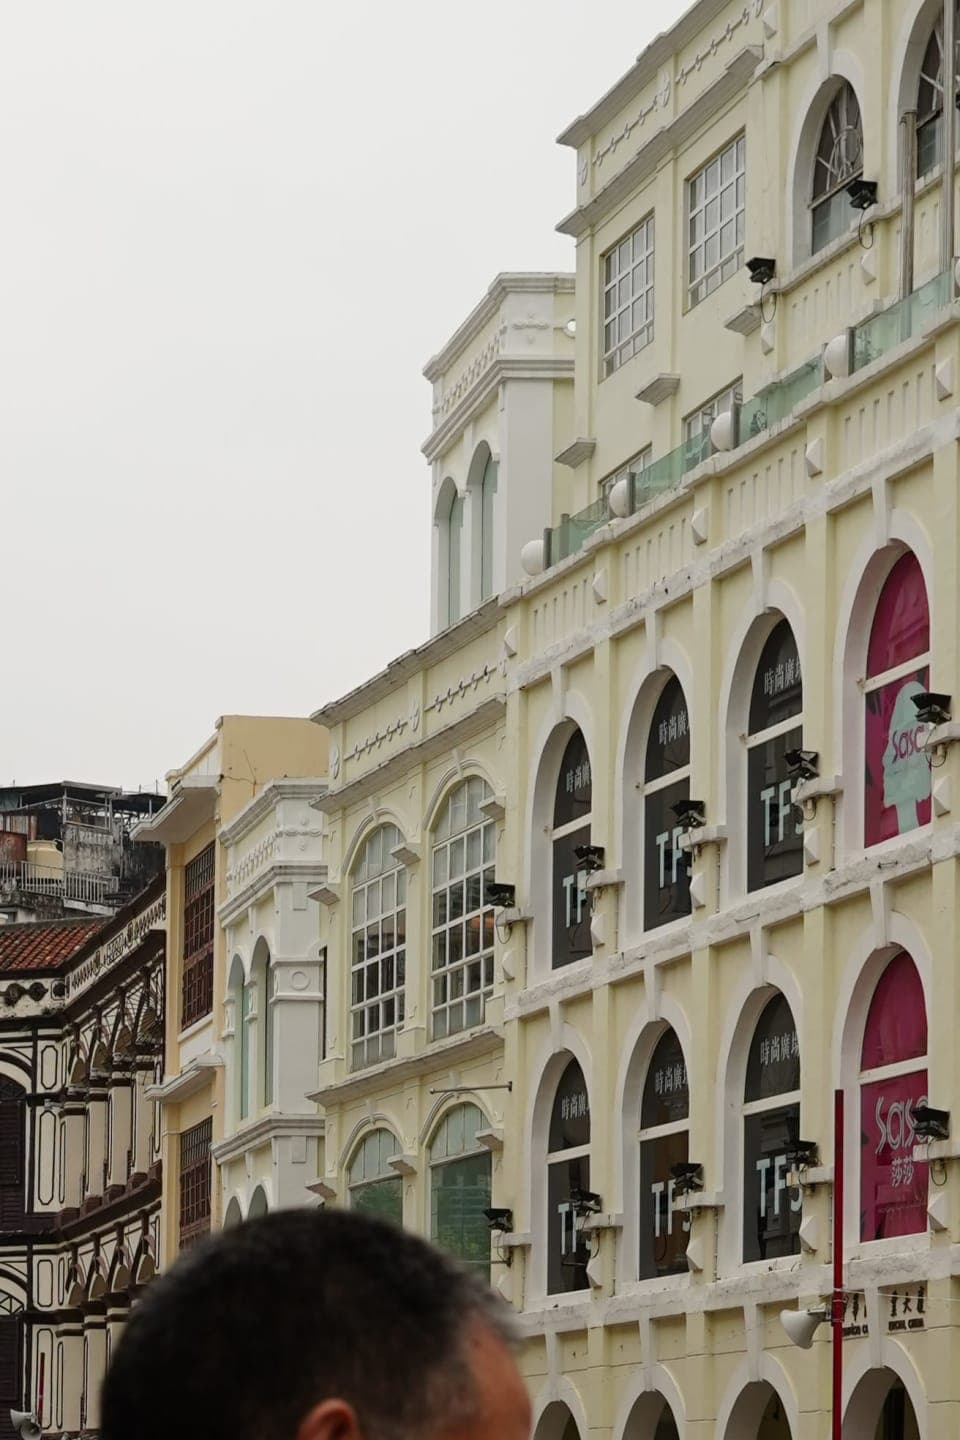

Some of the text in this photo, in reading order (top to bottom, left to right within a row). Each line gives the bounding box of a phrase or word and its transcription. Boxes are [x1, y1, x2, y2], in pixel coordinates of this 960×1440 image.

[659, 709, 689, 745] 時尚廣
[761, 779, 805, 847] TF
[656, 826, 693, 889] TF
[561, 1091, 590, 1120] 時尚廣
[891, 1156, 915, 1188] 莎莎
